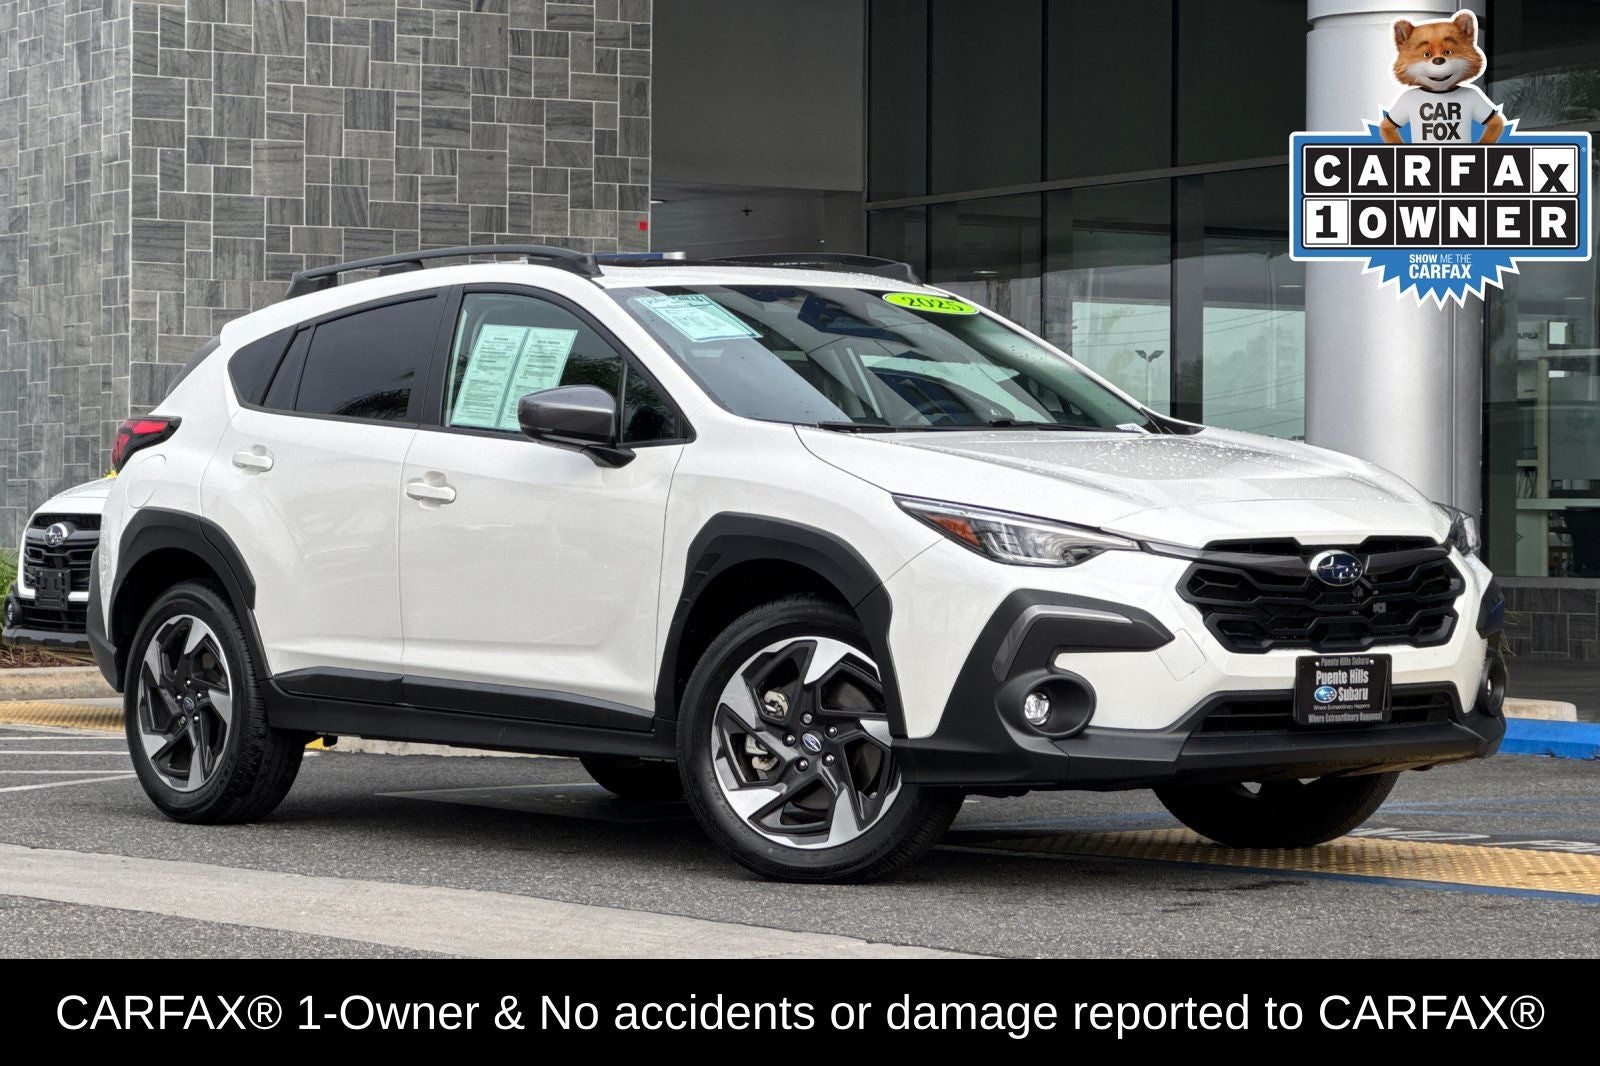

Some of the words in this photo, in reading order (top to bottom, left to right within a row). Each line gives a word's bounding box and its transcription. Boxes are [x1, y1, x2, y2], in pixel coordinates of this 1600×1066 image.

[901, 296, 964, 311] 2025
[1315, 669, 1348, 686] Puente
[1349, 668, 1369, 684] Hills
[1338, 686, 1369, 702] Subaru
